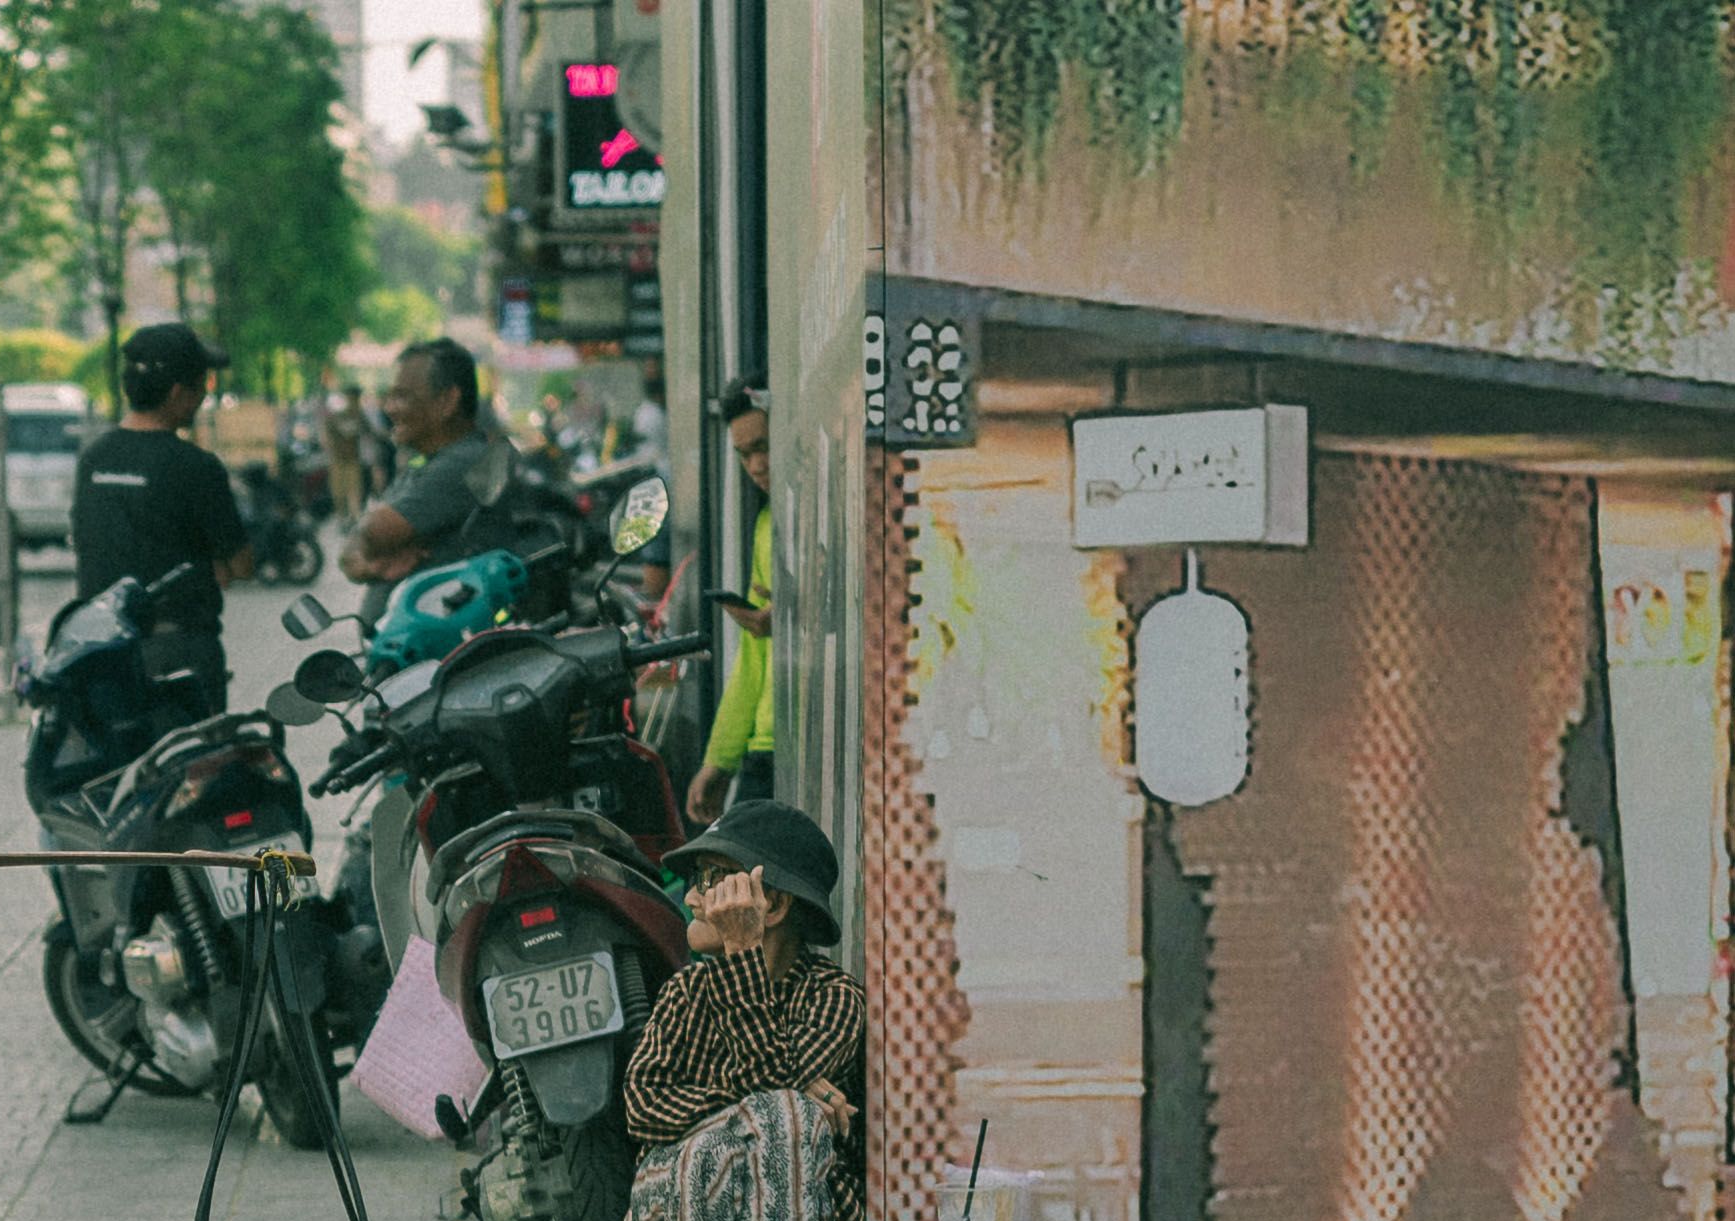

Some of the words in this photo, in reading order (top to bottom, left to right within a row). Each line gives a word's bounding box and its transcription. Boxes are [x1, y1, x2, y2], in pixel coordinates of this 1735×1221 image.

[524, 931, 562, 948] HONDA
[505, 964, 593, 1012] 52-U7
[511, 1000, 605, 1046] 3906
